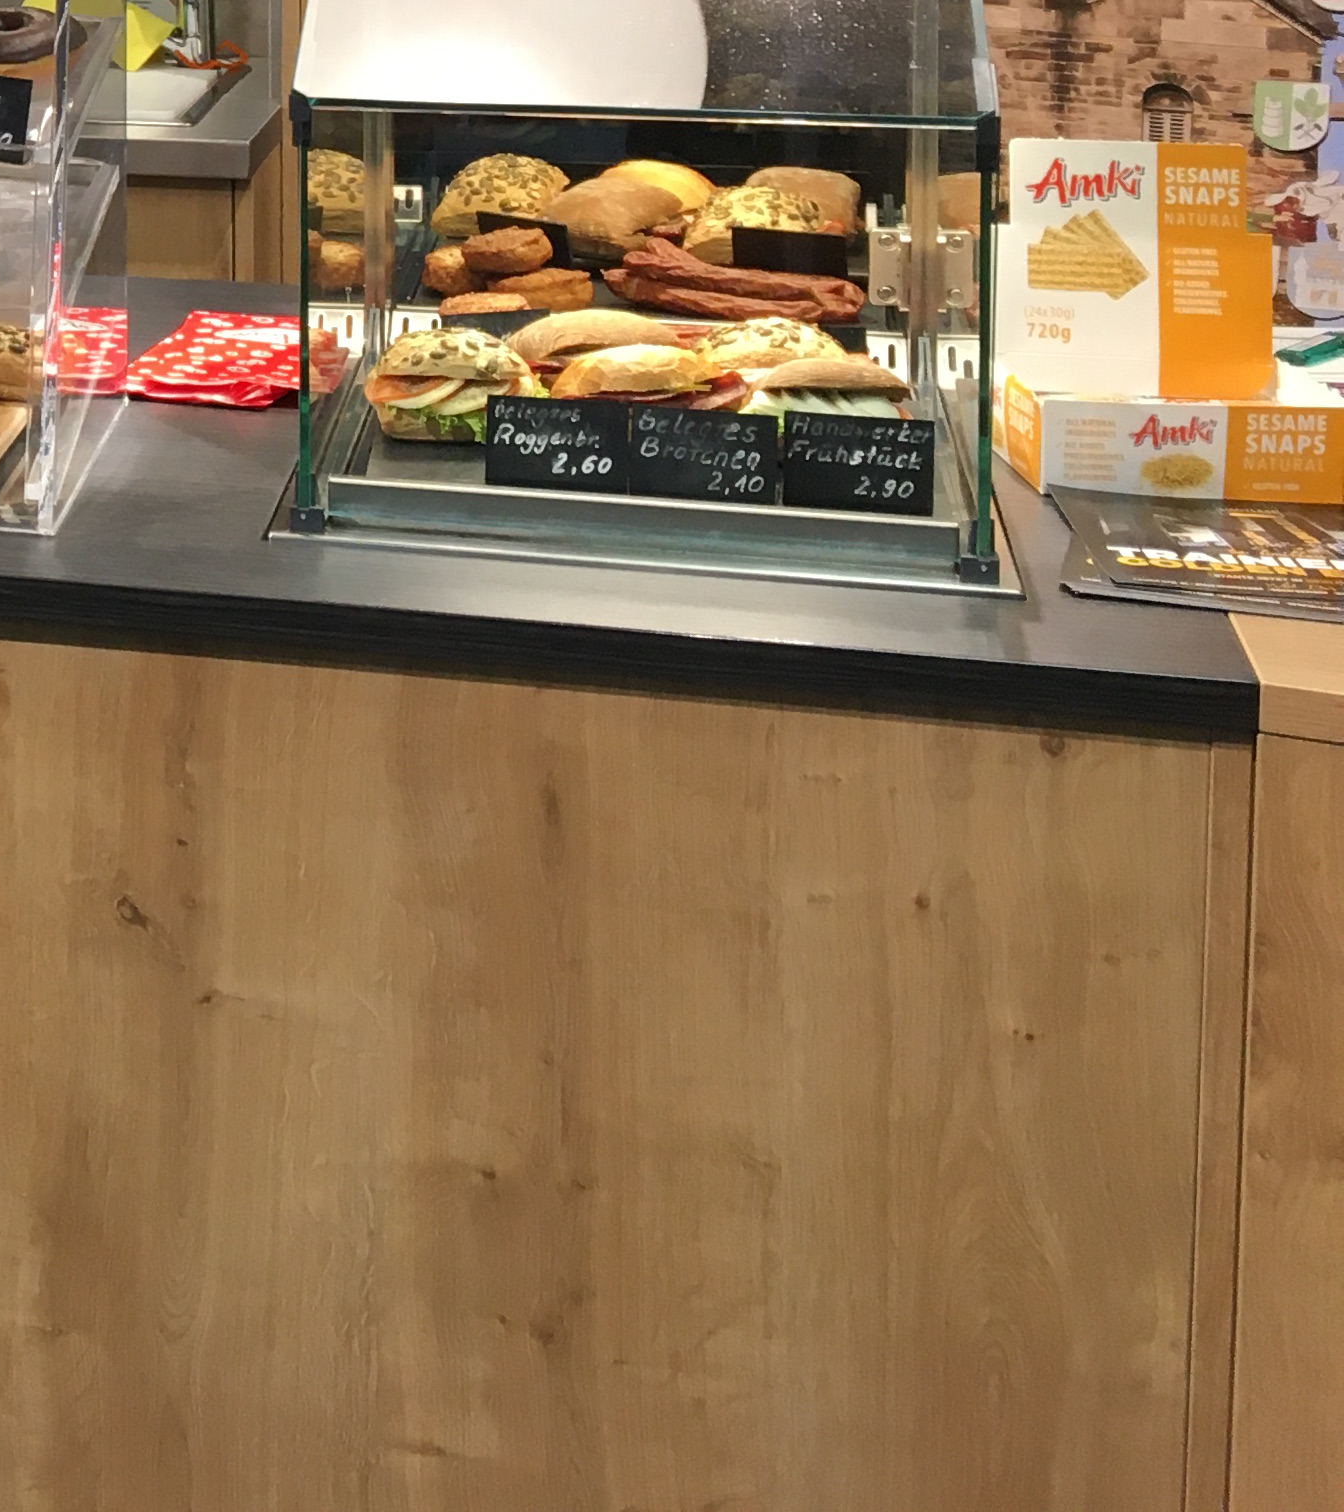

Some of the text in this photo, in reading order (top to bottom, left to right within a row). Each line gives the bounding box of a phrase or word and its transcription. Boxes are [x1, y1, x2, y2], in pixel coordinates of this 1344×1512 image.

[1025, 157, 1145, 208] Amki
[1164, 166, 1241, 185] SESAME
[1164, 185, 1241, 207] SNAPS
[1164, 211, 1242, 228] NATURAL
[1026, 322, 1072, 343] 720g
[1129, 414, 1217, 450] Amki
[1247, 413, 1328, 432] SESAME
[1245, 434, 1326, 455] SNAPS
[551, 452, 613, 476] 2,60
[1243, 457, 1325, 473] NATURAL
[707, 471, 765, 496] 2,10
[854, 475, 915, 499] 2,90
